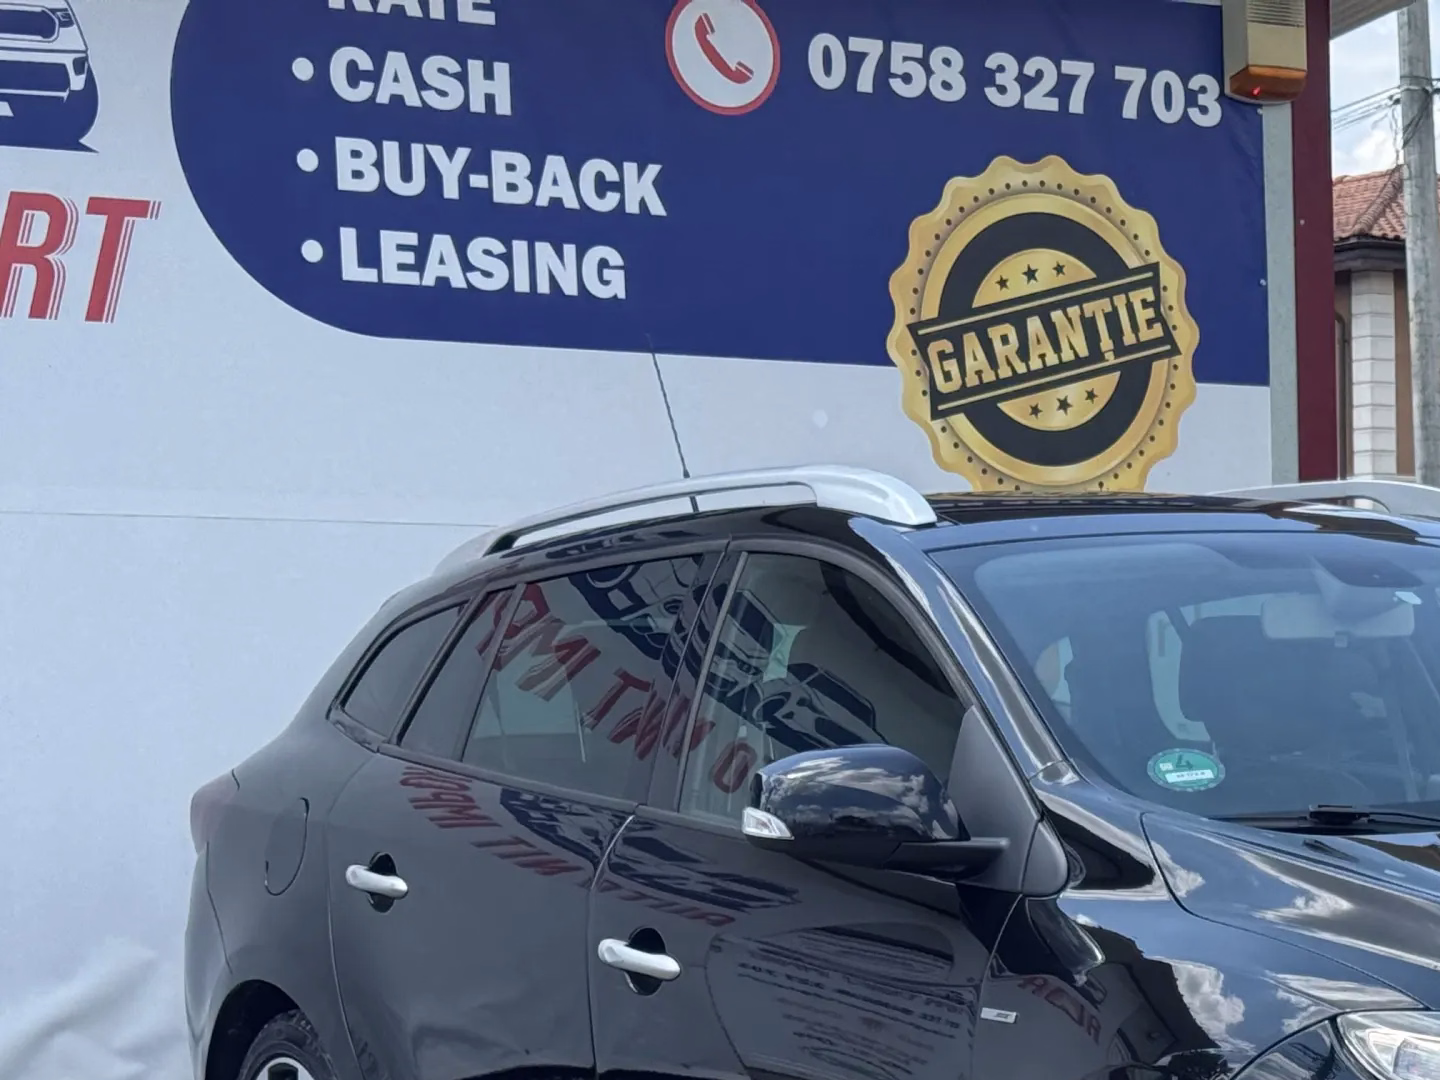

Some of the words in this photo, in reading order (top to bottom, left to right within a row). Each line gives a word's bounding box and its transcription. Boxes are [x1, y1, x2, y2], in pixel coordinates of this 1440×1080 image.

[329, 46, 512, 116] CASH
[808, 33, 967, 102] 0758
[983, 52, 1095, 114] 327
[1113, 65, 1223, 127] 703
[334, 136, 667, 216] BUY-BACK
[339, 227, 626, 299] LEASING
